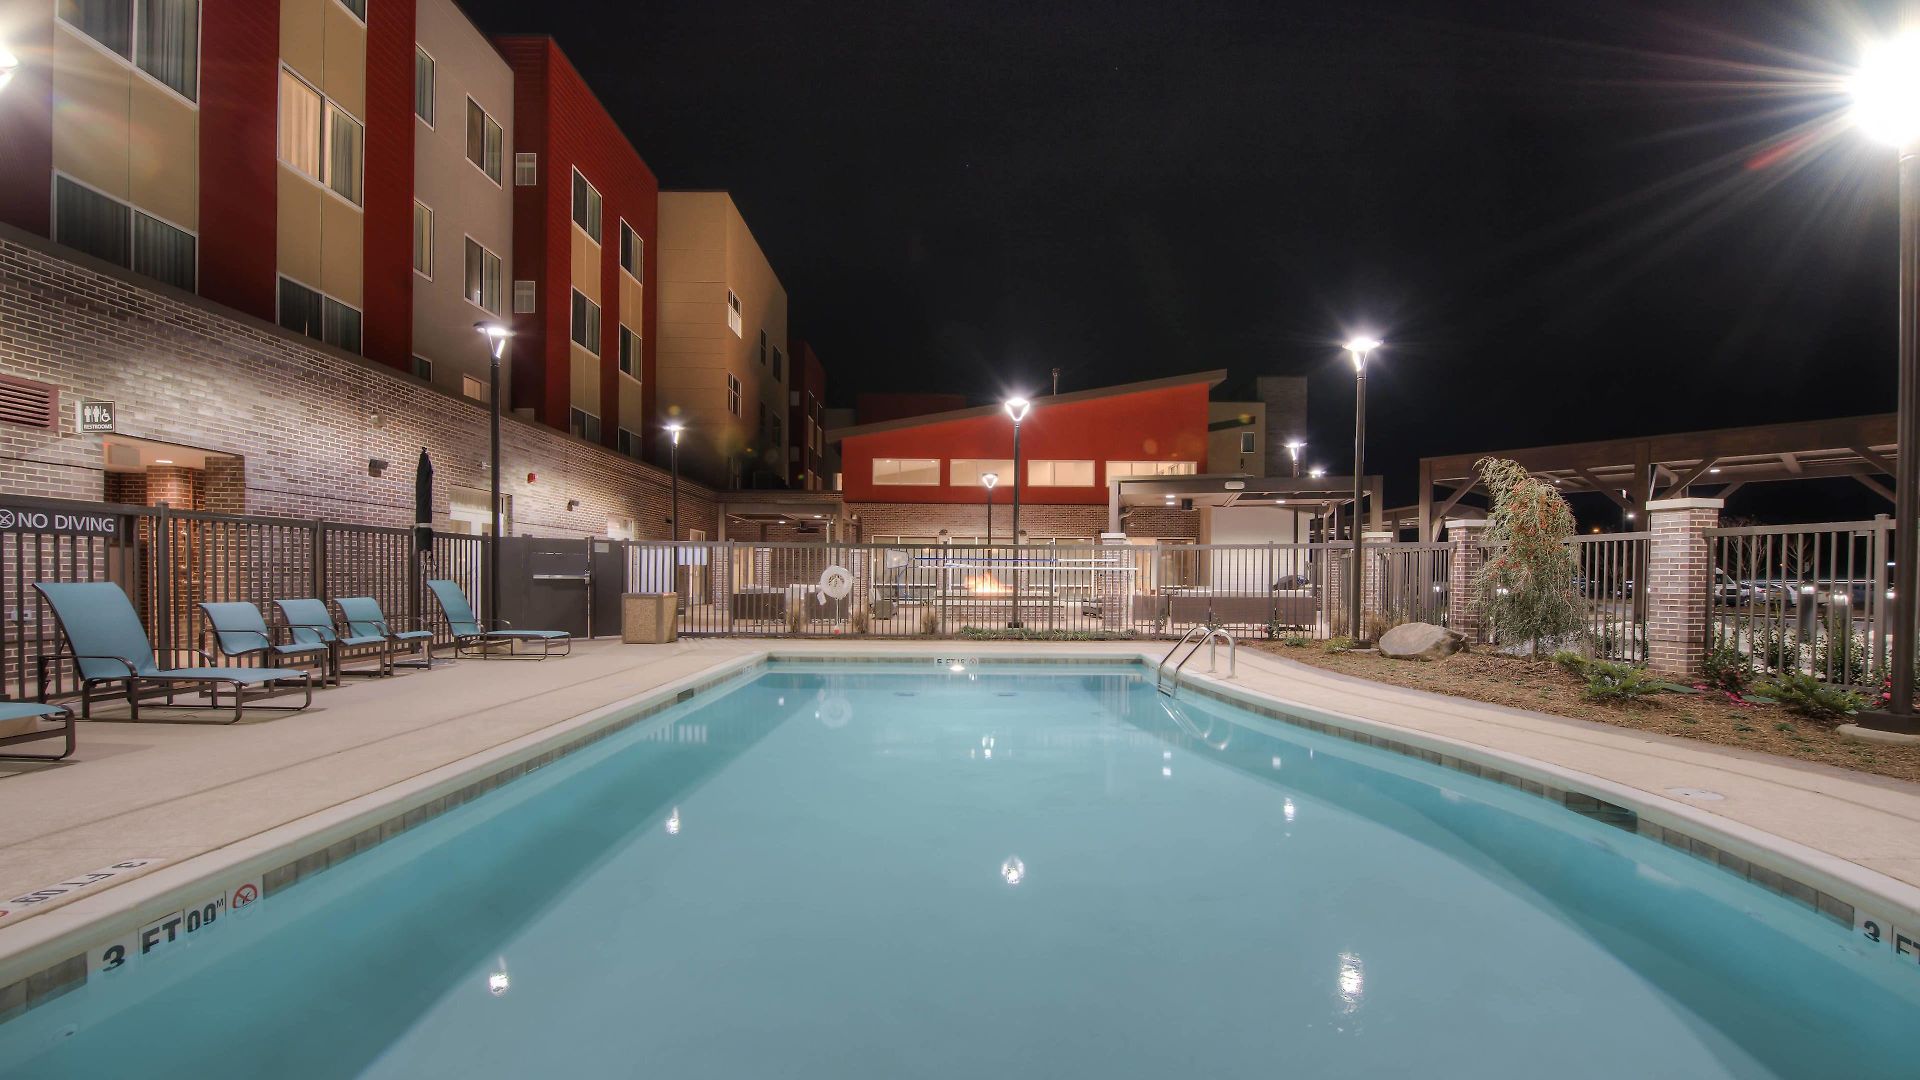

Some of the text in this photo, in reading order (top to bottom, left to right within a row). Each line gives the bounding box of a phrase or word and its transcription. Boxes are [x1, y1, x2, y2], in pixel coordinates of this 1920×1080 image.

[83, 423, 113, 431] RESTROOMS
[18, 512, 115, 533] NO DIVING
[102, 944, 126, 972] 3
[142, 917, 182, 955] FT
